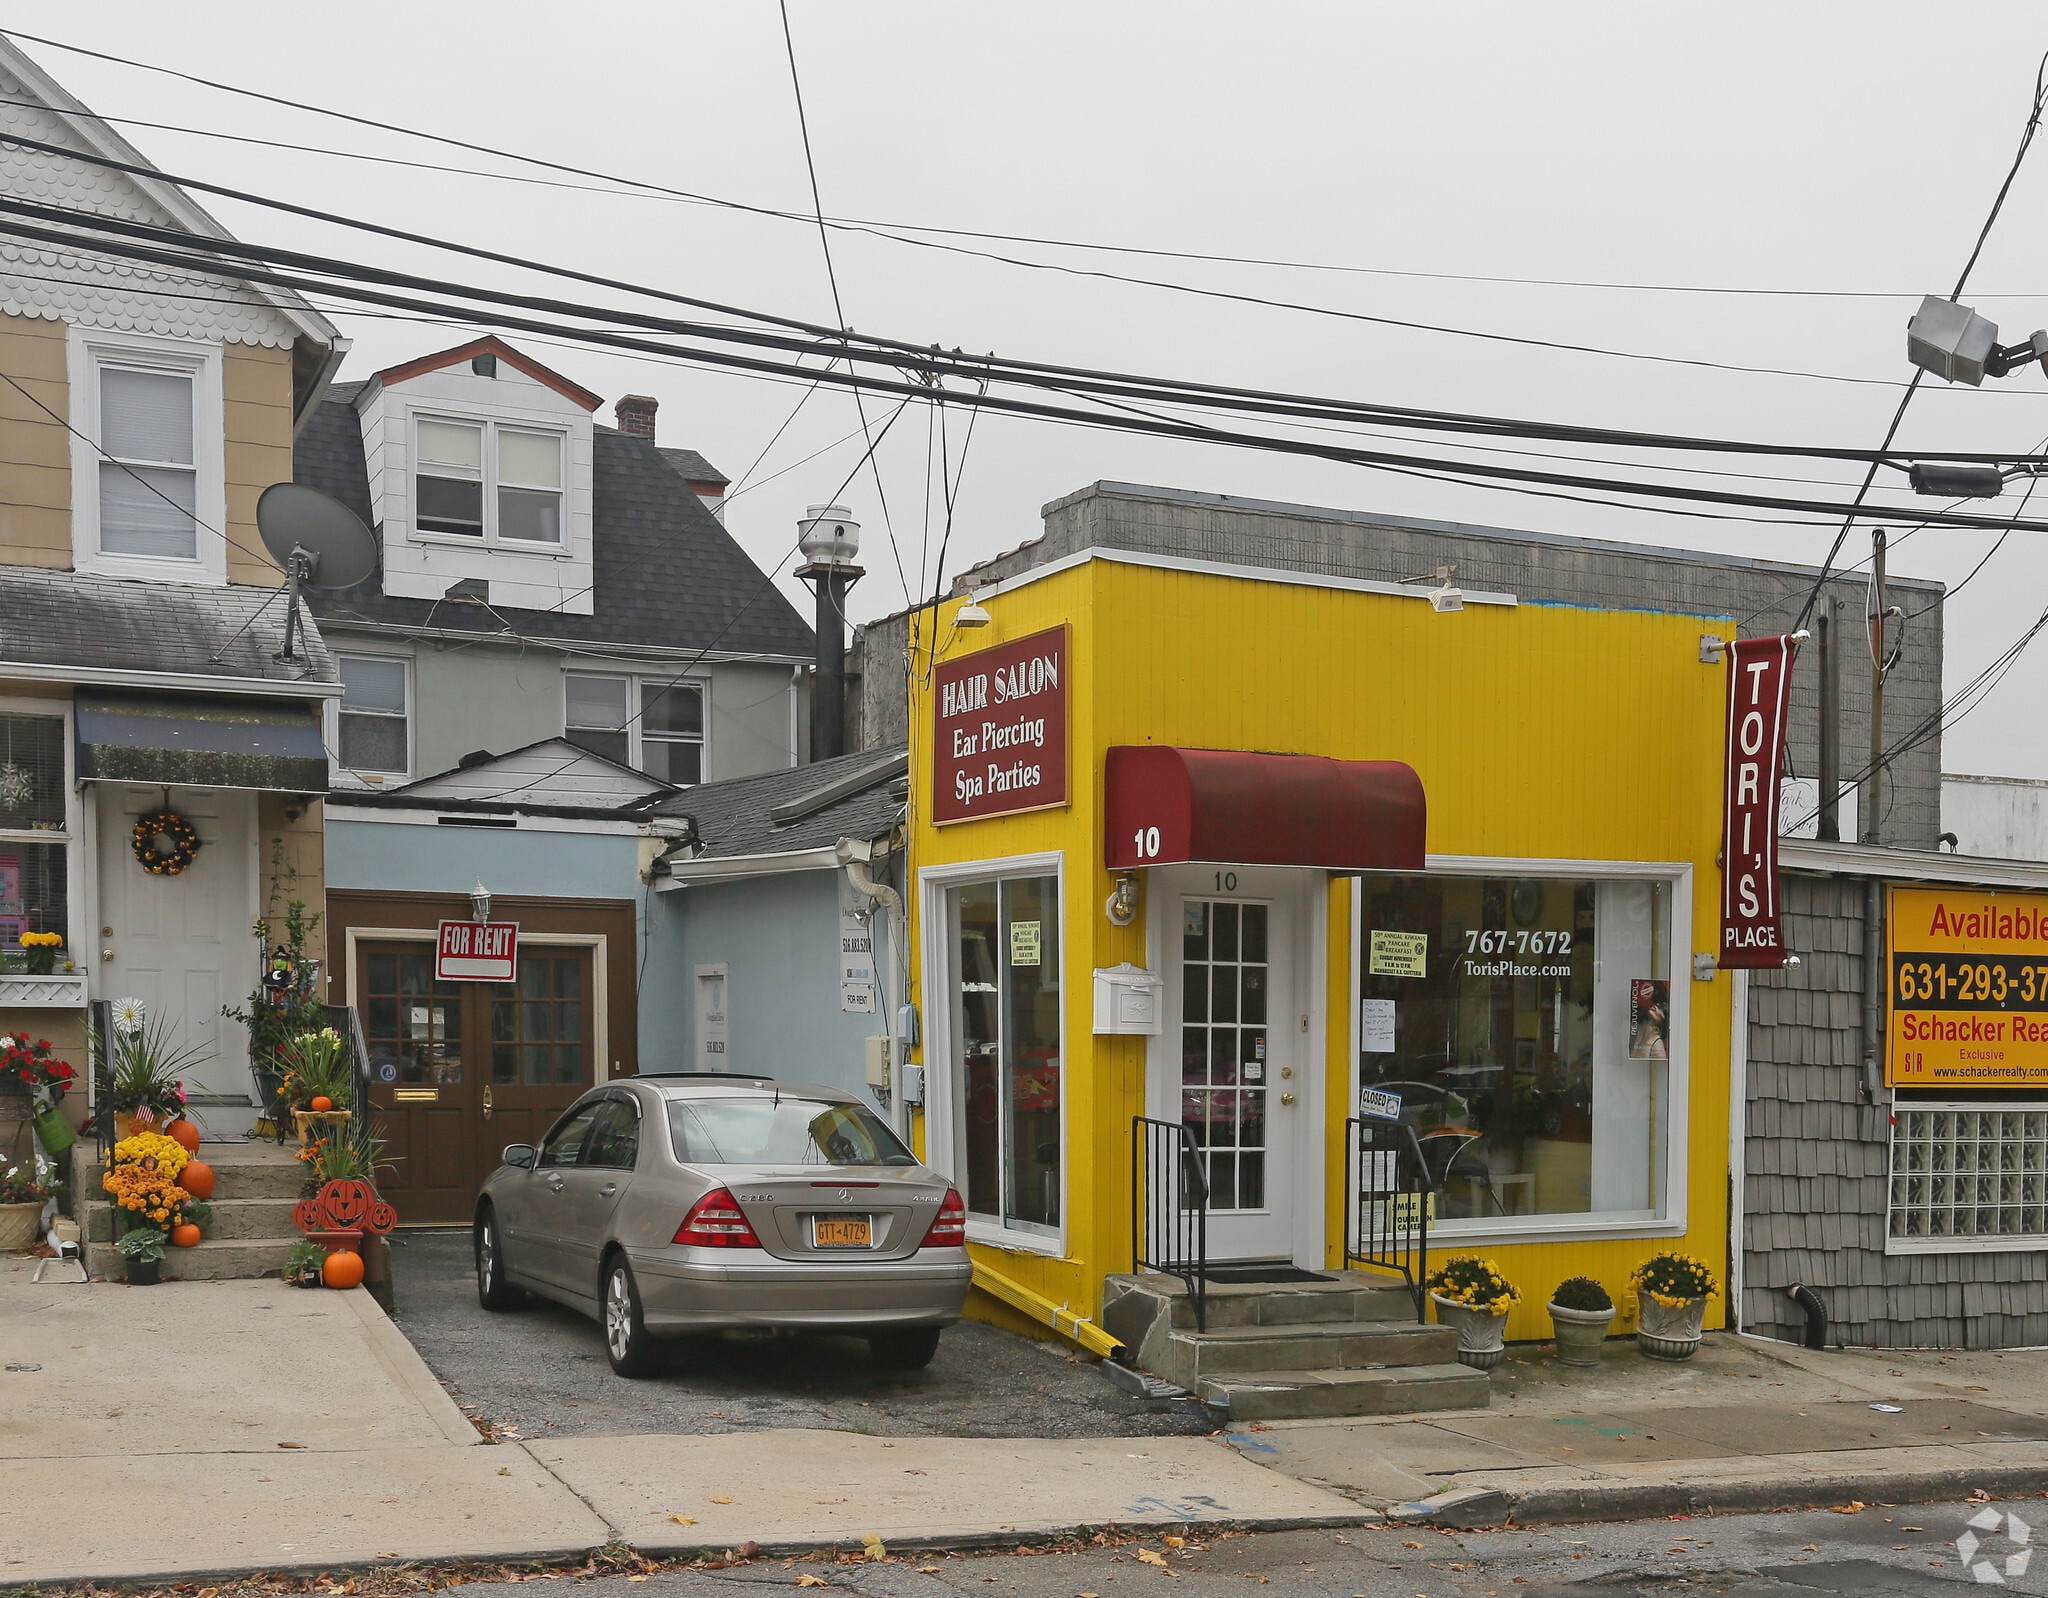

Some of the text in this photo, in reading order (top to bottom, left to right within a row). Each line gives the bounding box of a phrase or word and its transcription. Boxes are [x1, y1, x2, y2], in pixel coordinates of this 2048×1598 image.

[942, 652, 1058, 718] HAIR SALON
[953, 715, 1045, 758] Ear Piercing
[955, 760, 1041, 805] Spa Parties
[1737, 661, 1769, 918] TORI'S
[1134, 826, 1161, 858] 10
[1214, 871, 1238, 891] 10
[443, 926, 512, 956] FOR RENT
[1465, 930, 1571, 954] 767-7672
[1726, 926, 1777, 948] PLACE
[1464, 960, 1571, 976] TorisPlace.com
[847, 994, 868, 1005] FOR RENT
[1902, 1013, 2006, 1042] Schacker
[1960, 1049, 2004, 1060] Exclusive
[1934, 1065, 2048, 1080] www.schackerrealty.com
[1362, 1090, 1387, 1107] CLOSED
[1392, 1203, 1416, 1211] MIE
[818, 1223, 866, 1240] GTT 4729
